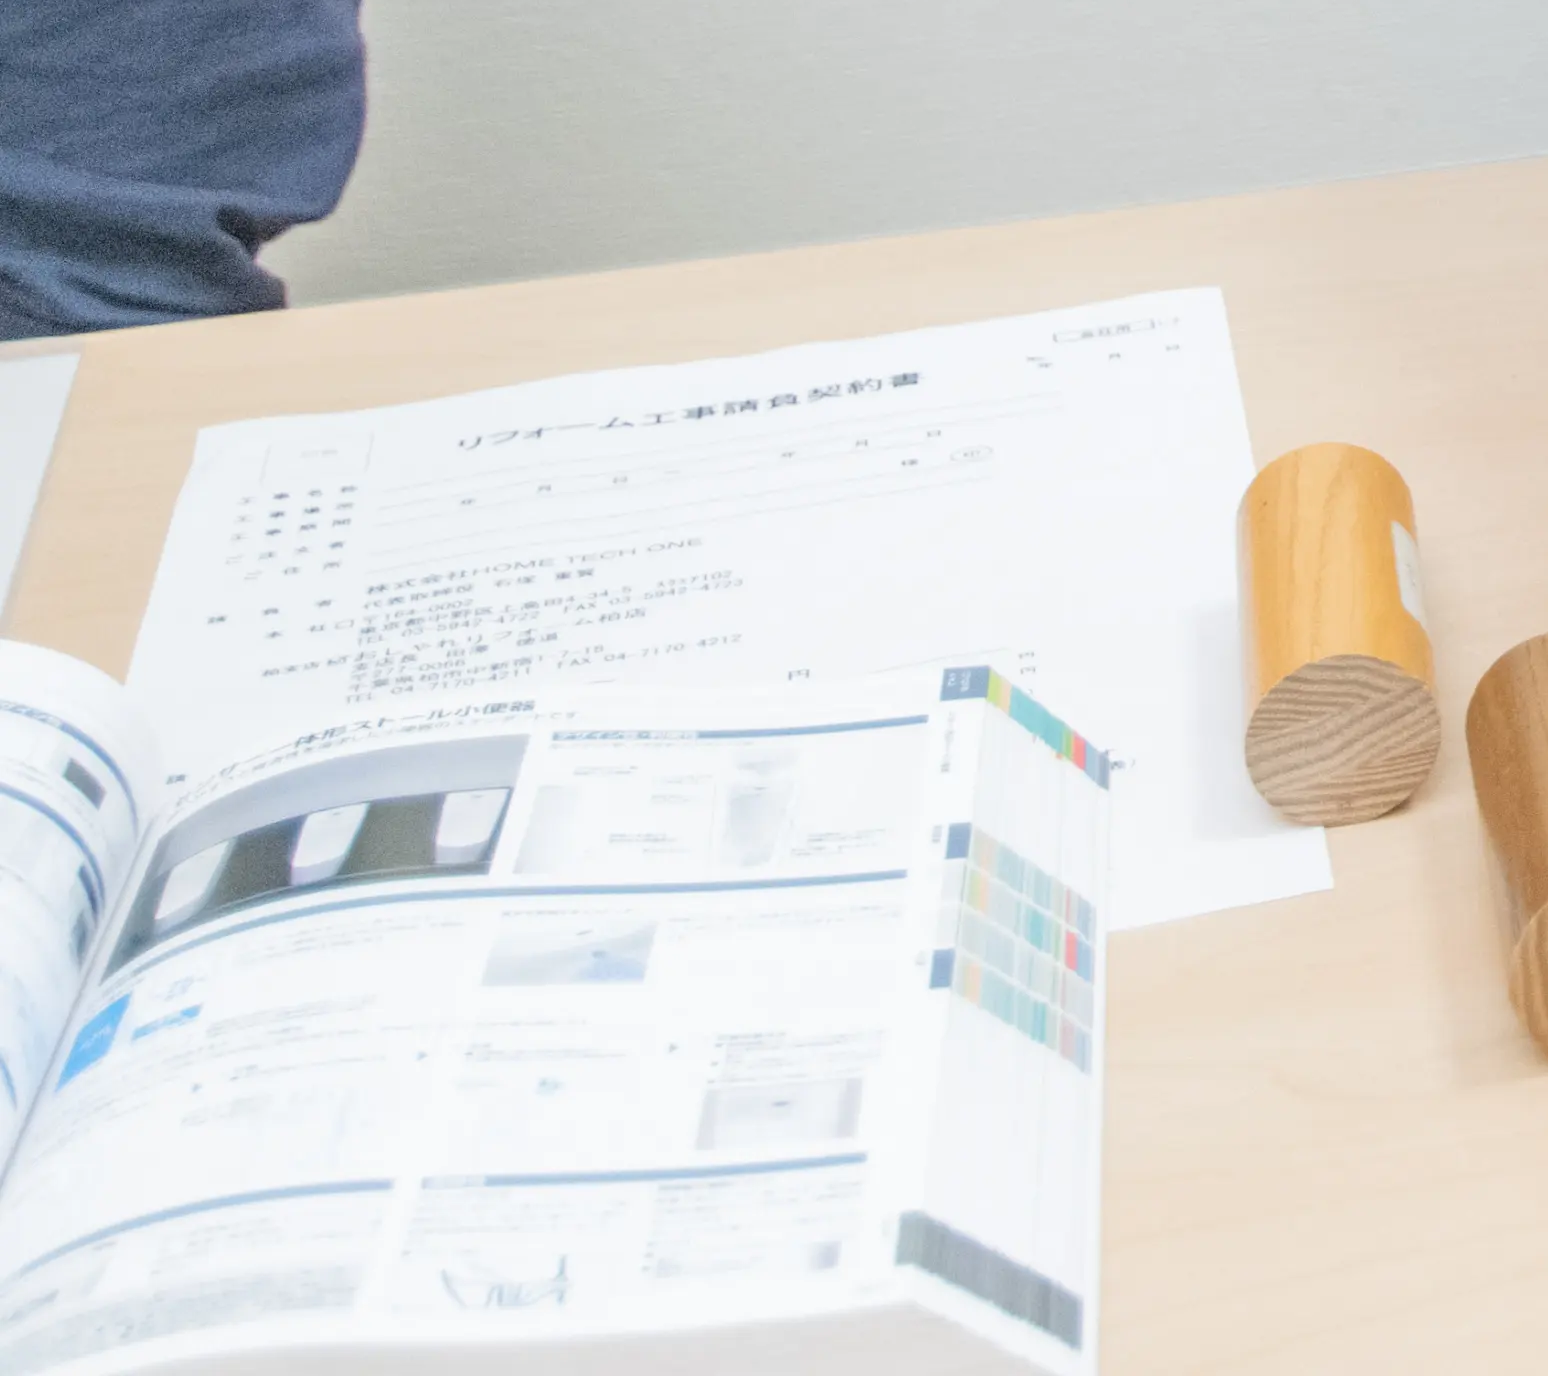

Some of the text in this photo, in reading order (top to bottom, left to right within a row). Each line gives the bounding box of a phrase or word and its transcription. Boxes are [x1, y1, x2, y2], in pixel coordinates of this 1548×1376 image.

[456, 369, 923, 451] リフォーム工事請負契約書
[566, 546, 637, 565] TECH
[645, 537, 705, 554] ONE
